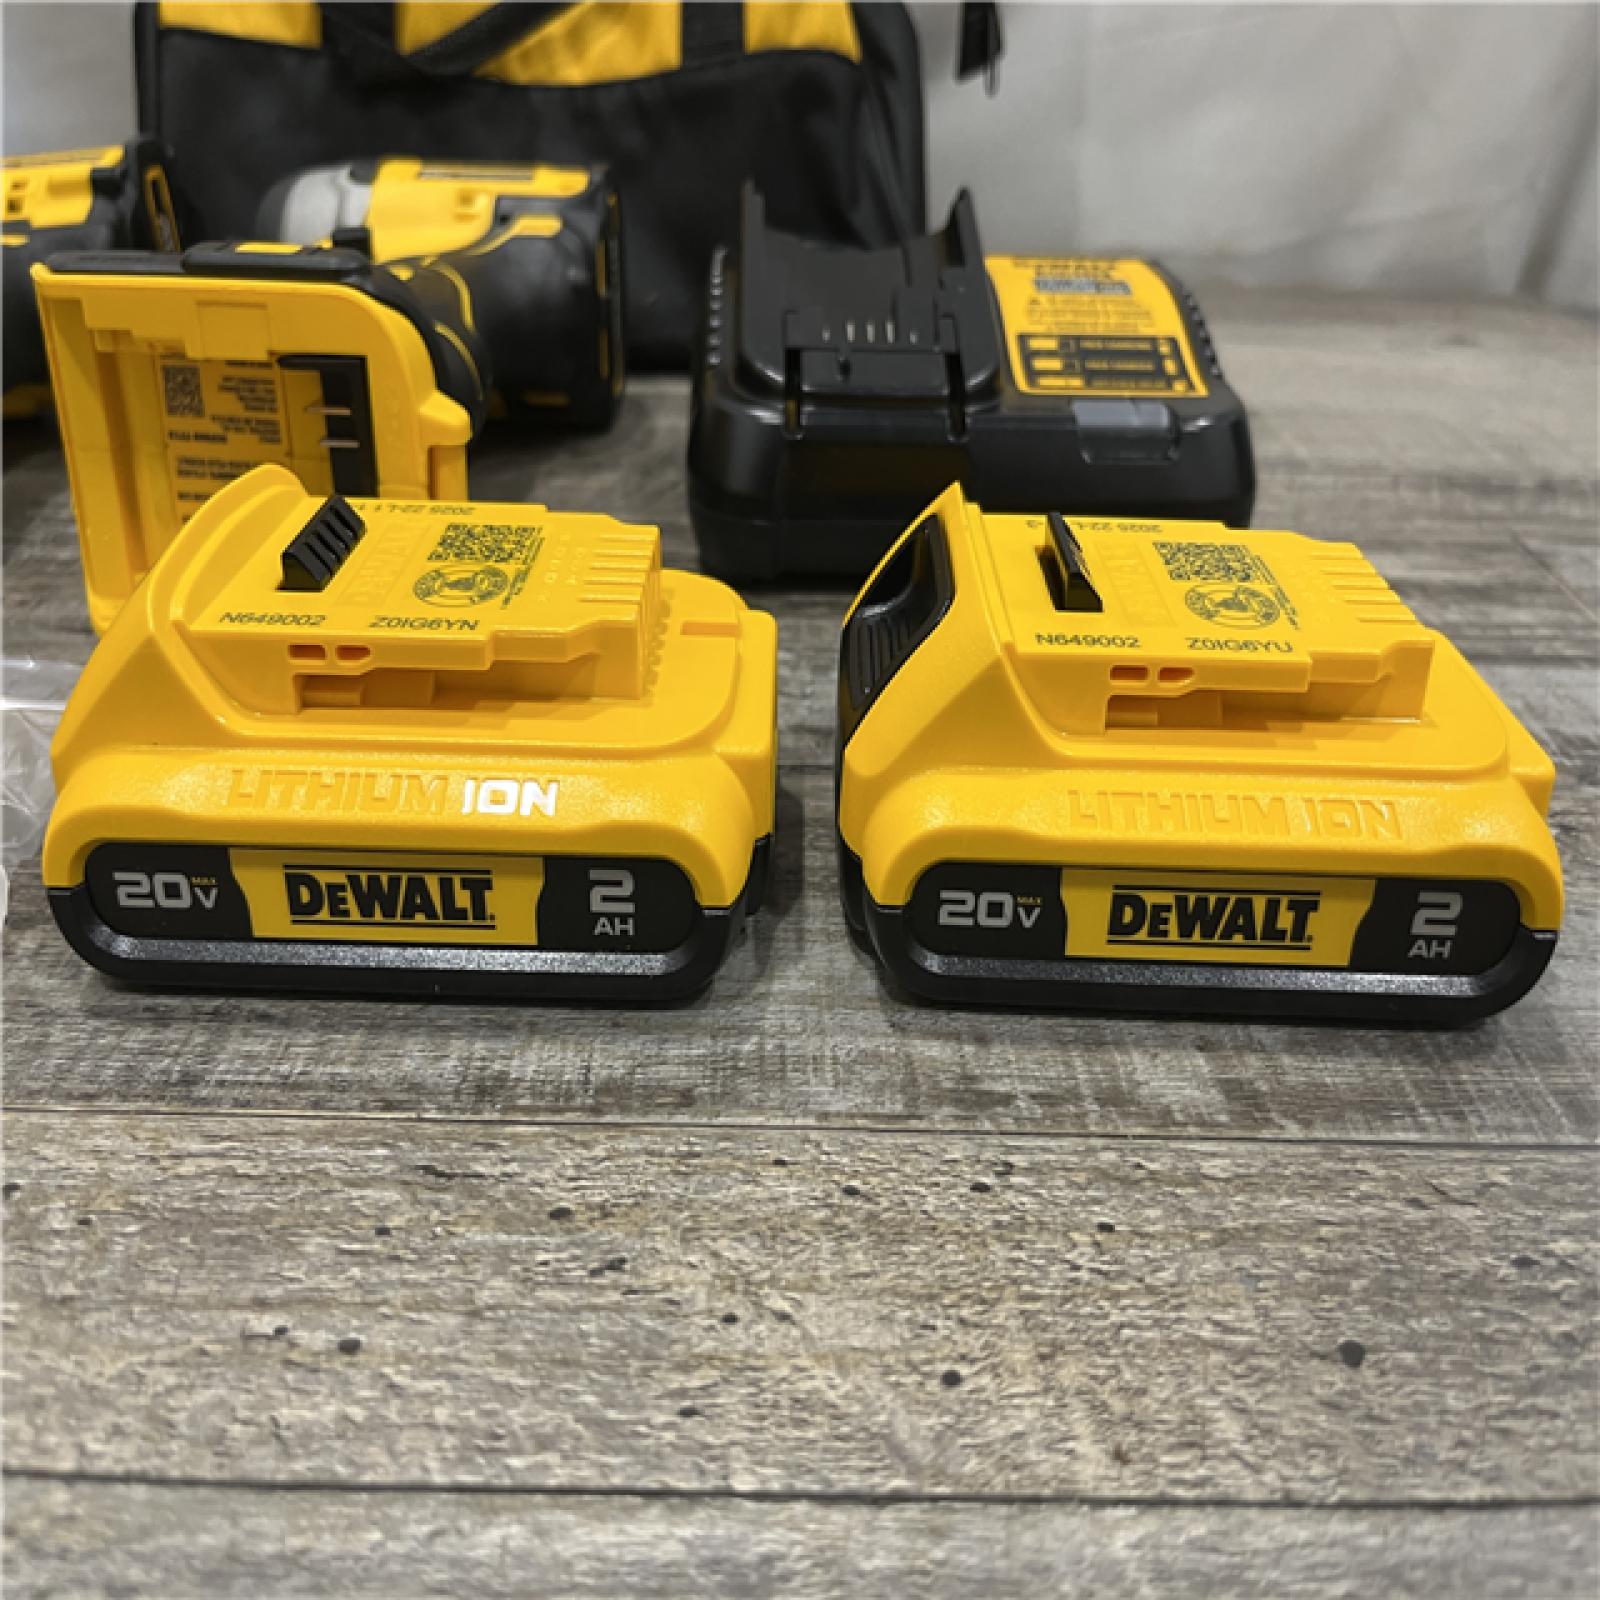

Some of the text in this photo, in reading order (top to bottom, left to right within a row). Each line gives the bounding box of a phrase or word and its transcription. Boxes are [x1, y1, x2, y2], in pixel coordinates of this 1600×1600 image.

[219, 612, 327, 625] N649002
[1034, 633, 1141, 648] N649002
[226, 769, 560, 817] LITHIUM ION
[1066, 789, 1404, 840] LITHIUM ION
[589, 869, 635, 913] 2
[594, 917, 635, 936] AH
[1411, 891, 1464, 936] 2
[1407, 939, 1452, 960] AH
